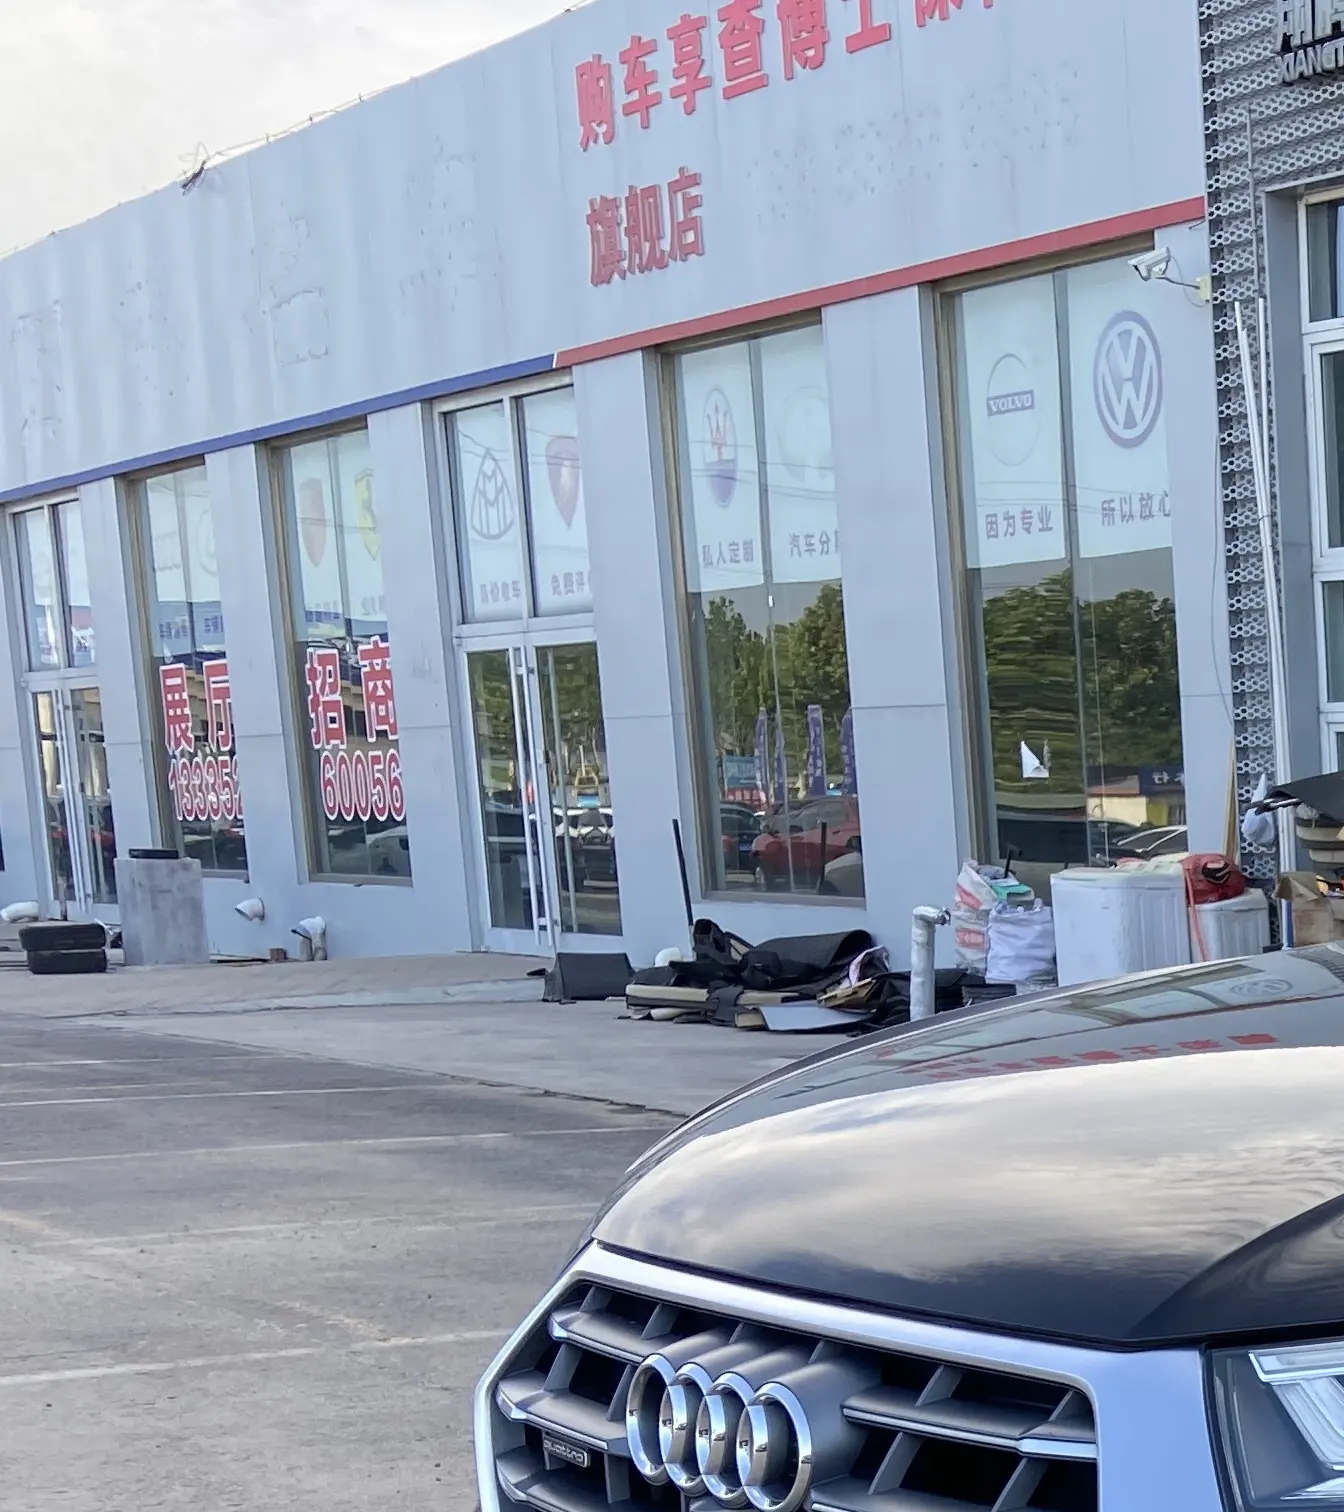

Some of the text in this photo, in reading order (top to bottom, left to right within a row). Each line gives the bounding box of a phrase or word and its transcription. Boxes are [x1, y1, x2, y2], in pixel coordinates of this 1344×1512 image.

[575, 0, 993, 152] 购车享查博士
[586, 166, 704, 286] 旗舰店
[988, 395, 1033, 413] VOLVO
[788, 529, 839, 559] 汽车分
[985, 505, 1053, 540] 因为专业
[159, 658, 232, 754] 展厅
[305, 636, 398, 749] 招商
[320, 749, 405, 821] 60056
[543, 1439, 585, 1463] quattro
